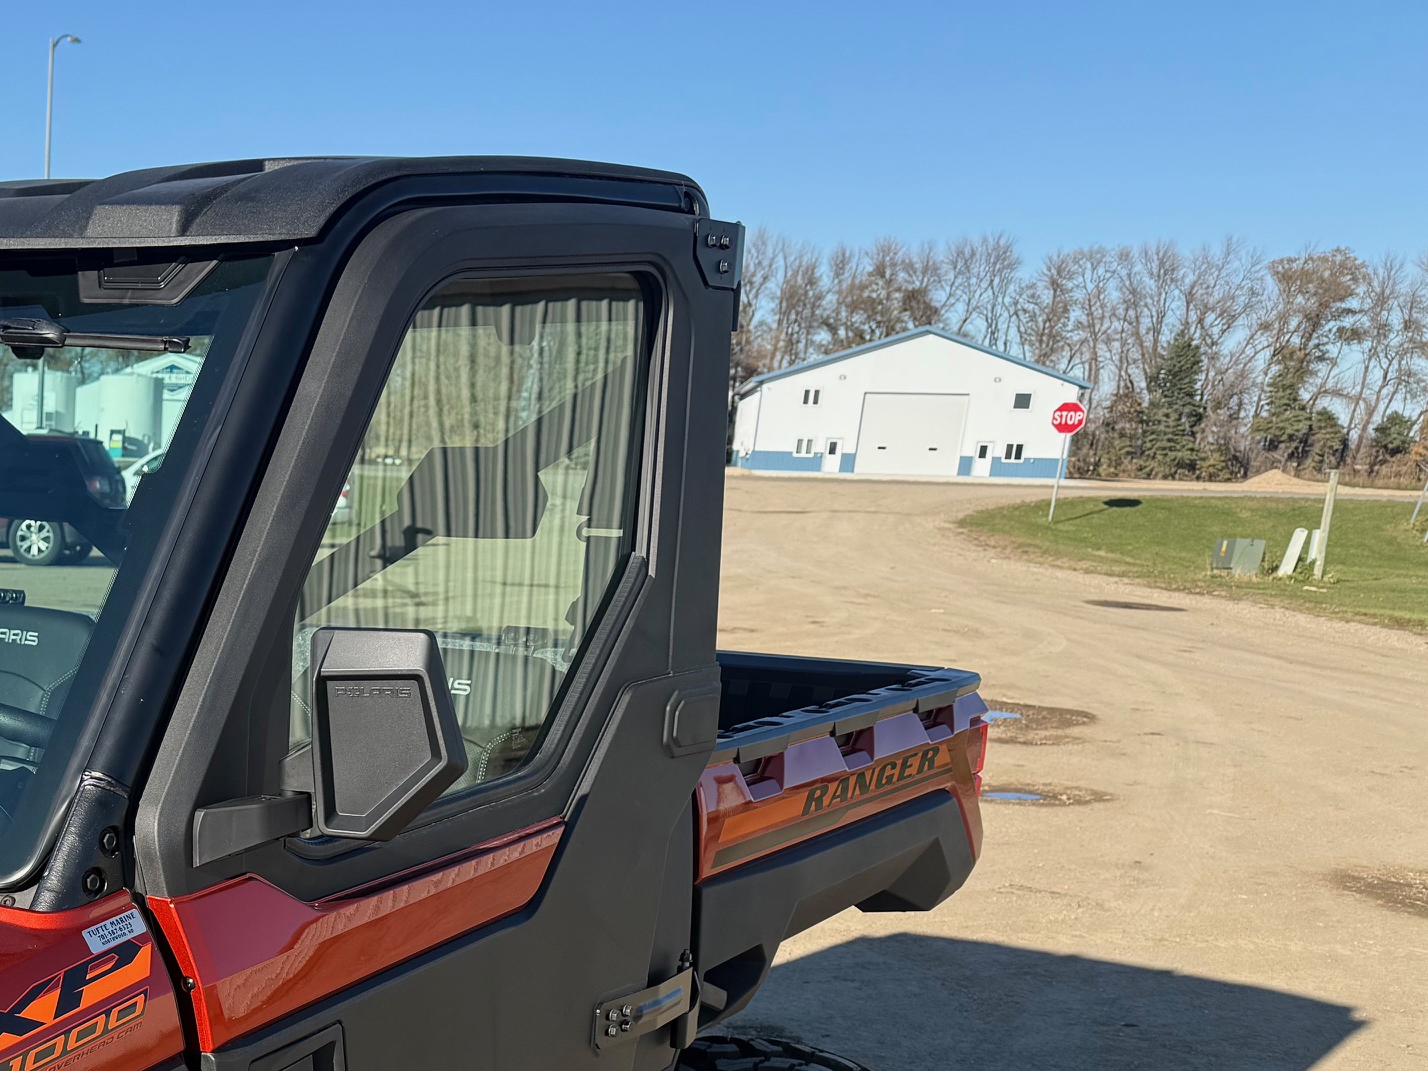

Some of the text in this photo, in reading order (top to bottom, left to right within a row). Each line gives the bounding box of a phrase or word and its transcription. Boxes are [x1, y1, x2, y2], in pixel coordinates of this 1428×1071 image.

[1053, 410, 1084, 425] STOP
[335, 686, 412, 698] POLARIS
[801, 745, 941, 817] RANGER
[87, 911, 136, 938] TUFTE MARINE
[115, 1020, 143, 1040] CAM
